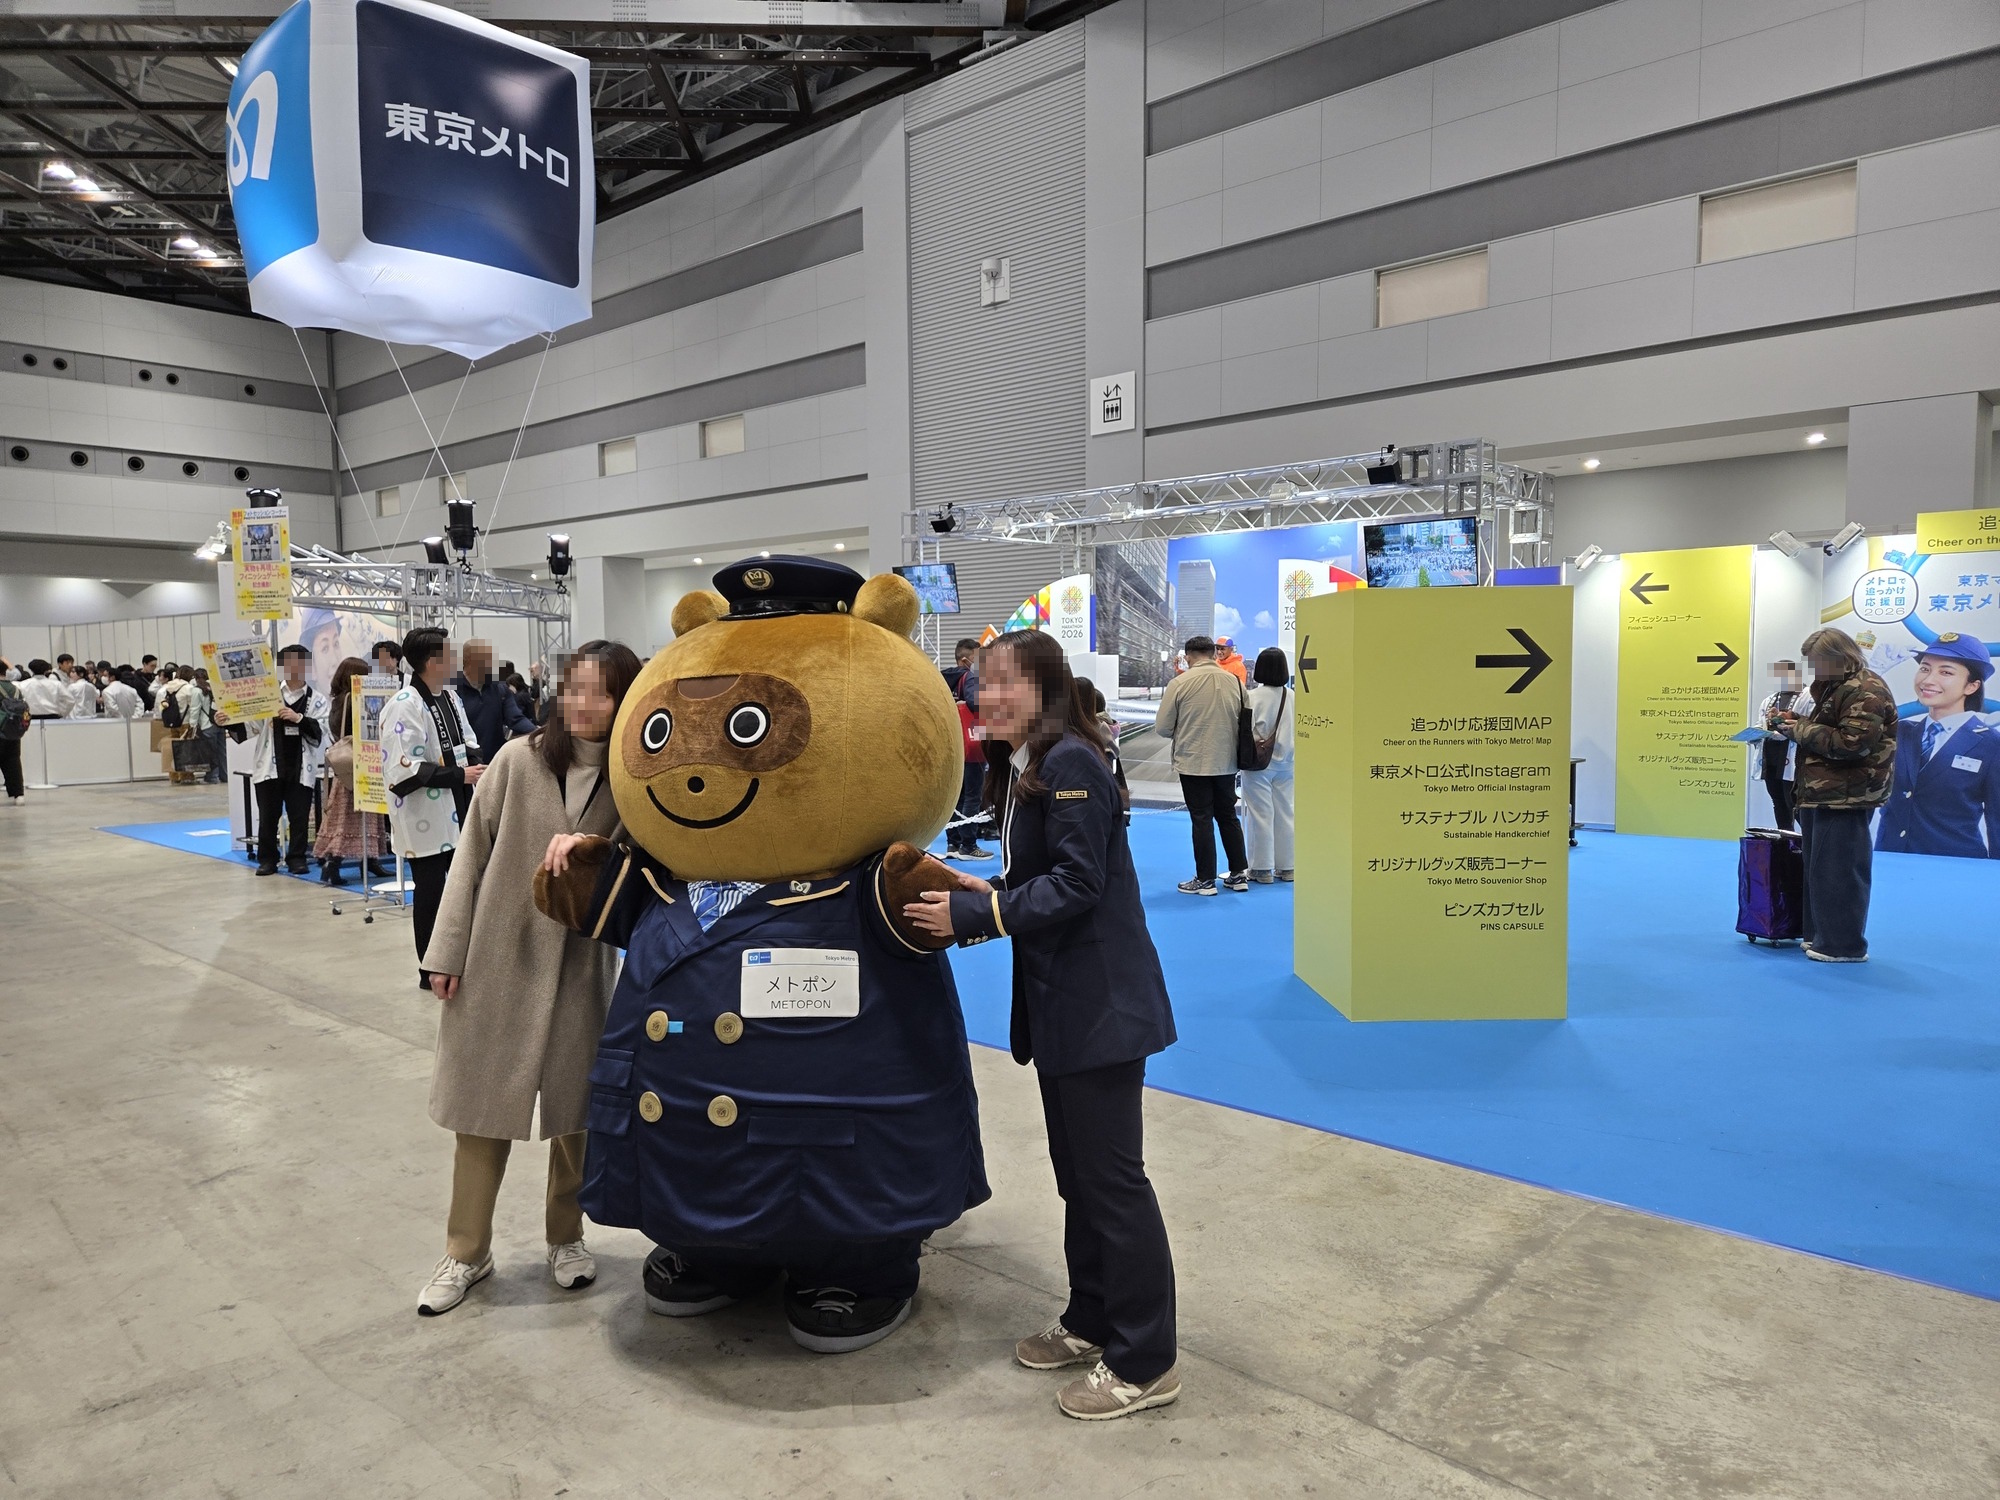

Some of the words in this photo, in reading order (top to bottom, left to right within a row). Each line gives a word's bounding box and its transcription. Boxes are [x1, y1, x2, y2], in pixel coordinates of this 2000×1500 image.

[385, 101, 570, 188] 東京メトロ
[1979, 515, 2000, 531] 追
[1927, 538, 1962, 548] Cheer
[1967, 537, 1983, 546] on
[1866, 576, 1906, 586] メトロで
[1865, 586, 1905, 596] 追っかけ
[1865, 596, 1905, 607] 応援団
[1928, 593, 2000, 612] 東京メ
[1864, 607, 1905, 616] 2026
[1628, 614, 1702, 624] フィニッシュコーナー
[1061, 630, 1084, 638] 2026
[1661, 686, 1740, 694] 追っかけ応援団MAP
[1640, 709, 1739, 718] 東京メトロ公式Instagram
[1411, 716, 1552, 732] 追っかけ応援団MAP
[1383, 738, 1406, 746] Cheer
[1485, 737, 1508, 746] Tokyo
[1509, 737, 1534, 745] Metro!
[1536, 737, 1552, 746] Map
[1656, 732, 1703, 741] サステナブル
[1705, 733, 1734, 741] ハンカ
[1639, 755, 1736, 765] オリジナルグッズ販売コーナー
[1370, 763, 1551, 780] 東京メトロ公式Instagram
[1424, 784, 1449, 793] Tokyo
[1477, 784, 1507, 792] Official
[1509, 784, 1551, 793] Instagram
[1400, 810, 1487, 825] サステナブル
[1492, 810, 1550, 824] ハンカチ
[1443, 831, 1493, 839] Sustainable
[1495, 830, 1550, 838] Handkerchief
[1367, 856, 1547, 872] オリジナルグッズ販売コーナー
[1427, 877, 1452, 886] Tokyo
[1454, 877, 1478, 885] Metro
[1480, 877, 1522, 885] Souvenior
[1525, 877, 1547, 885] Shop
[1444, 902, 1545, 917] ピンズカプセル
[1480, 923, 1500, 931] PINS
[1503, 922, 1545, 931] CAPSULE
[766, 975, 837, 994] メトポン
[770, 1000, 831, 1010] METOPON
